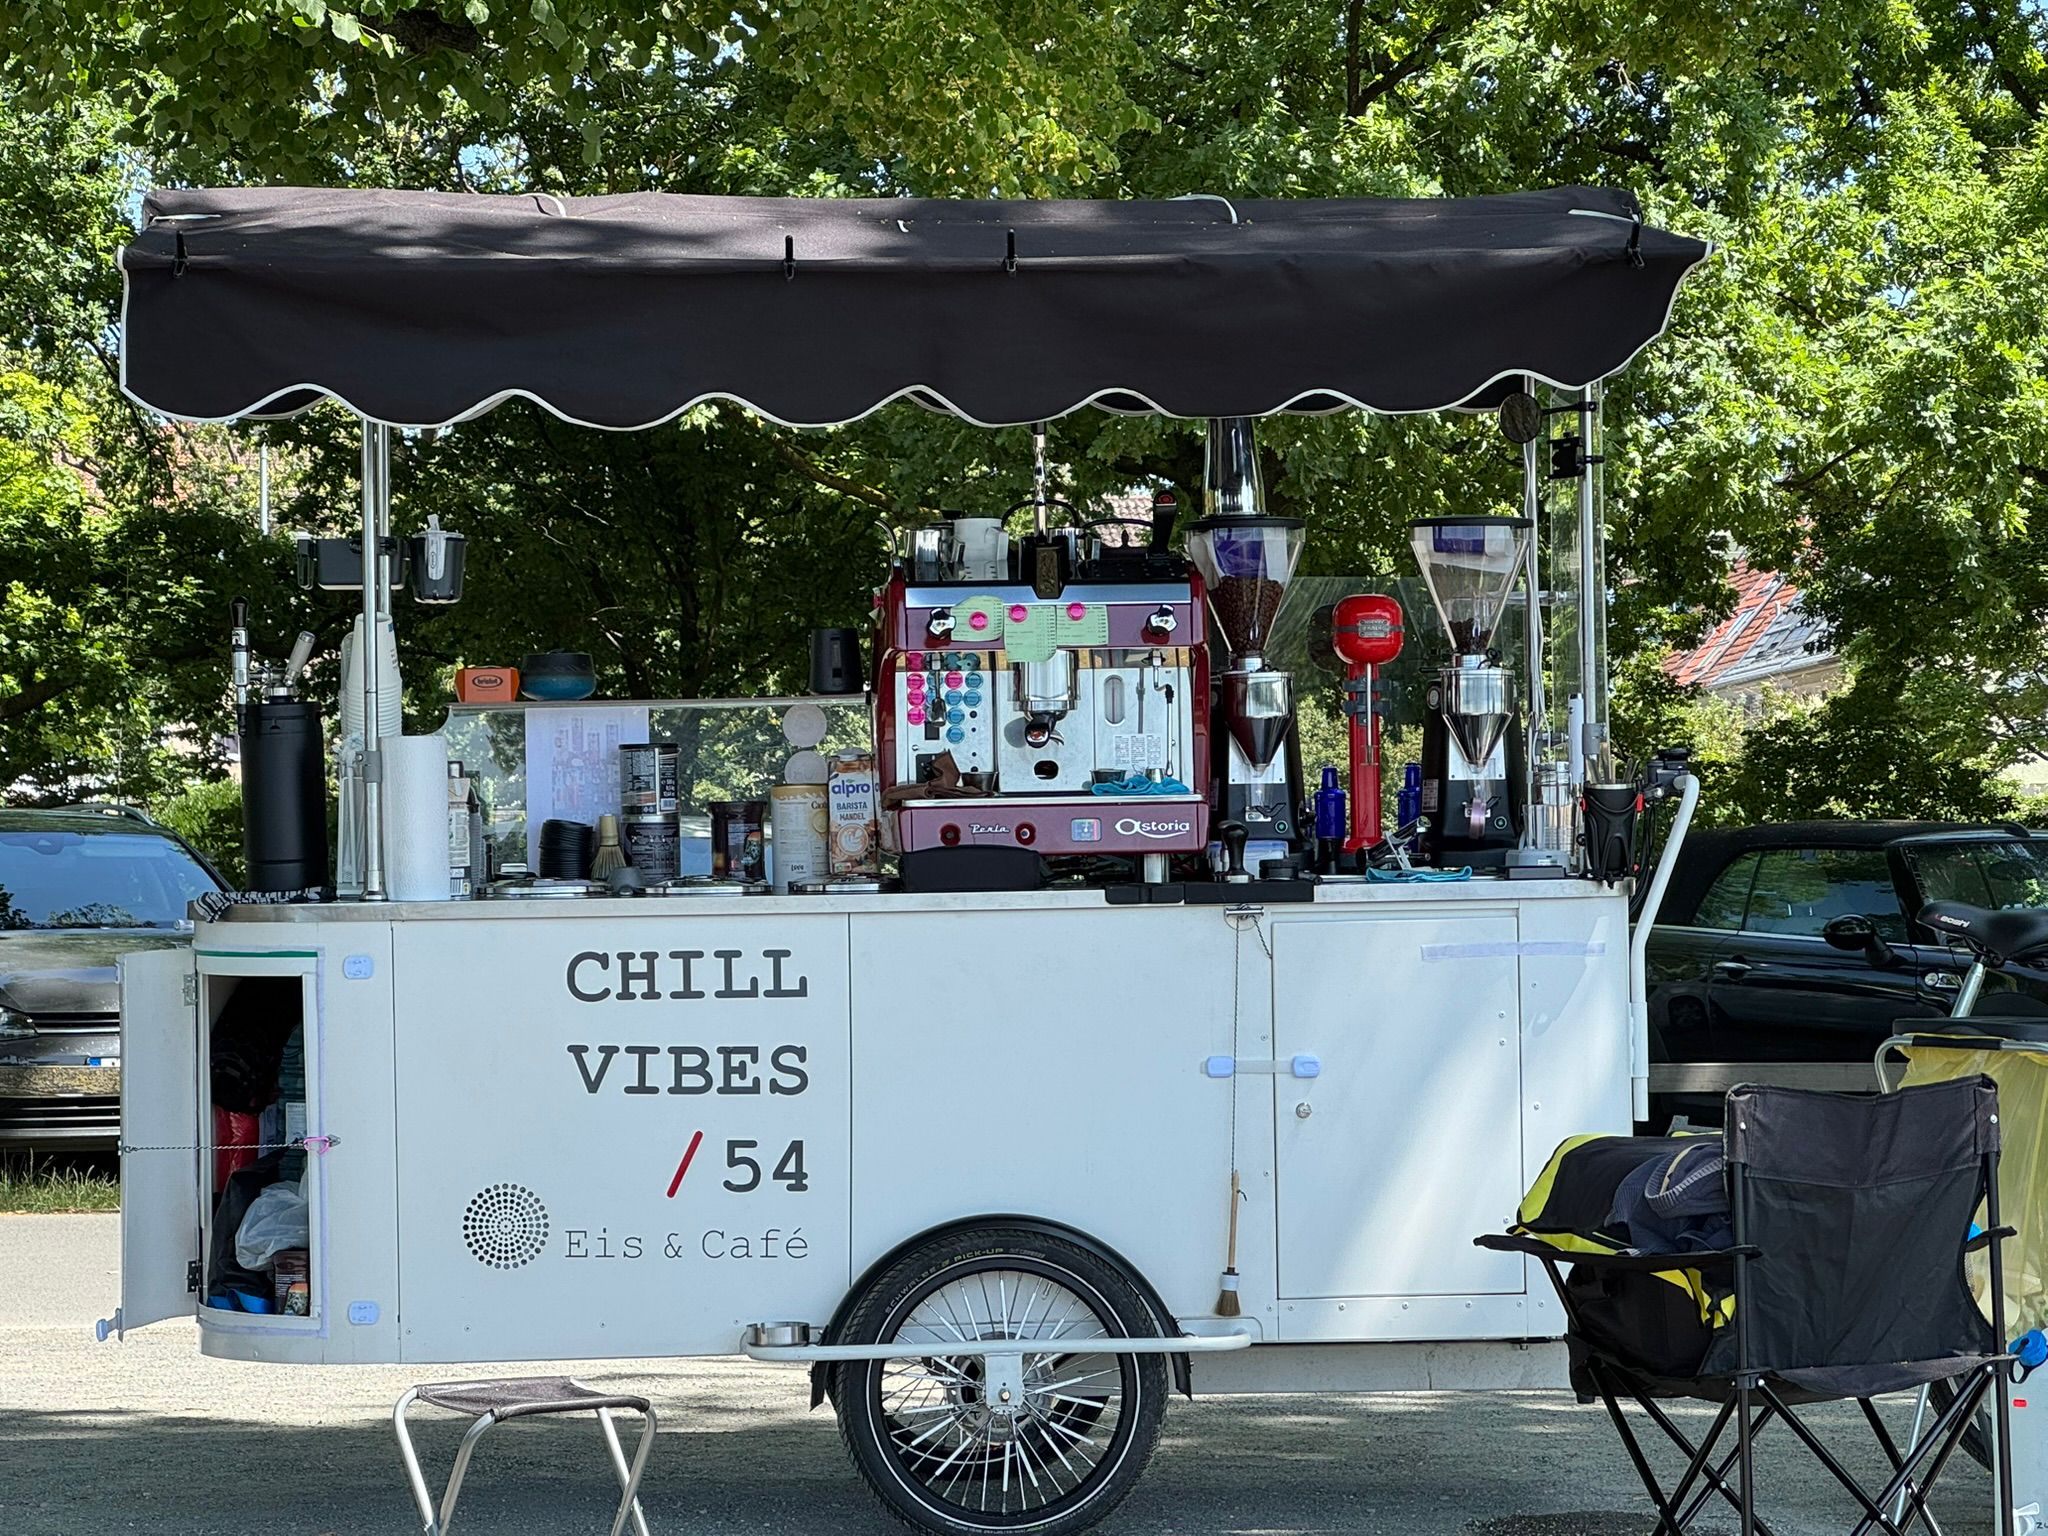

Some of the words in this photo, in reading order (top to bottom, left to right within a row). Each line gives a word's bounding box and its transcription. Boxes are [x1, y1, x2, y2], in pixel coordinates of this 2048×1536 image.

[831, 780, 871, 798] alpro
[836, 801, 868, 811] BARISTA
[839, 812, 866, 821] MANDEL
[566, 949, 809, 1003] CHILL
[566, 1044, 809, 1096] VIBES
[564, 1227, 643, 1259] Eis
[663, 1232, 683, 1259] &
[701, 1227, 809, 1259] Café
[954, 1247, 1004, 1262] PICK-UP
